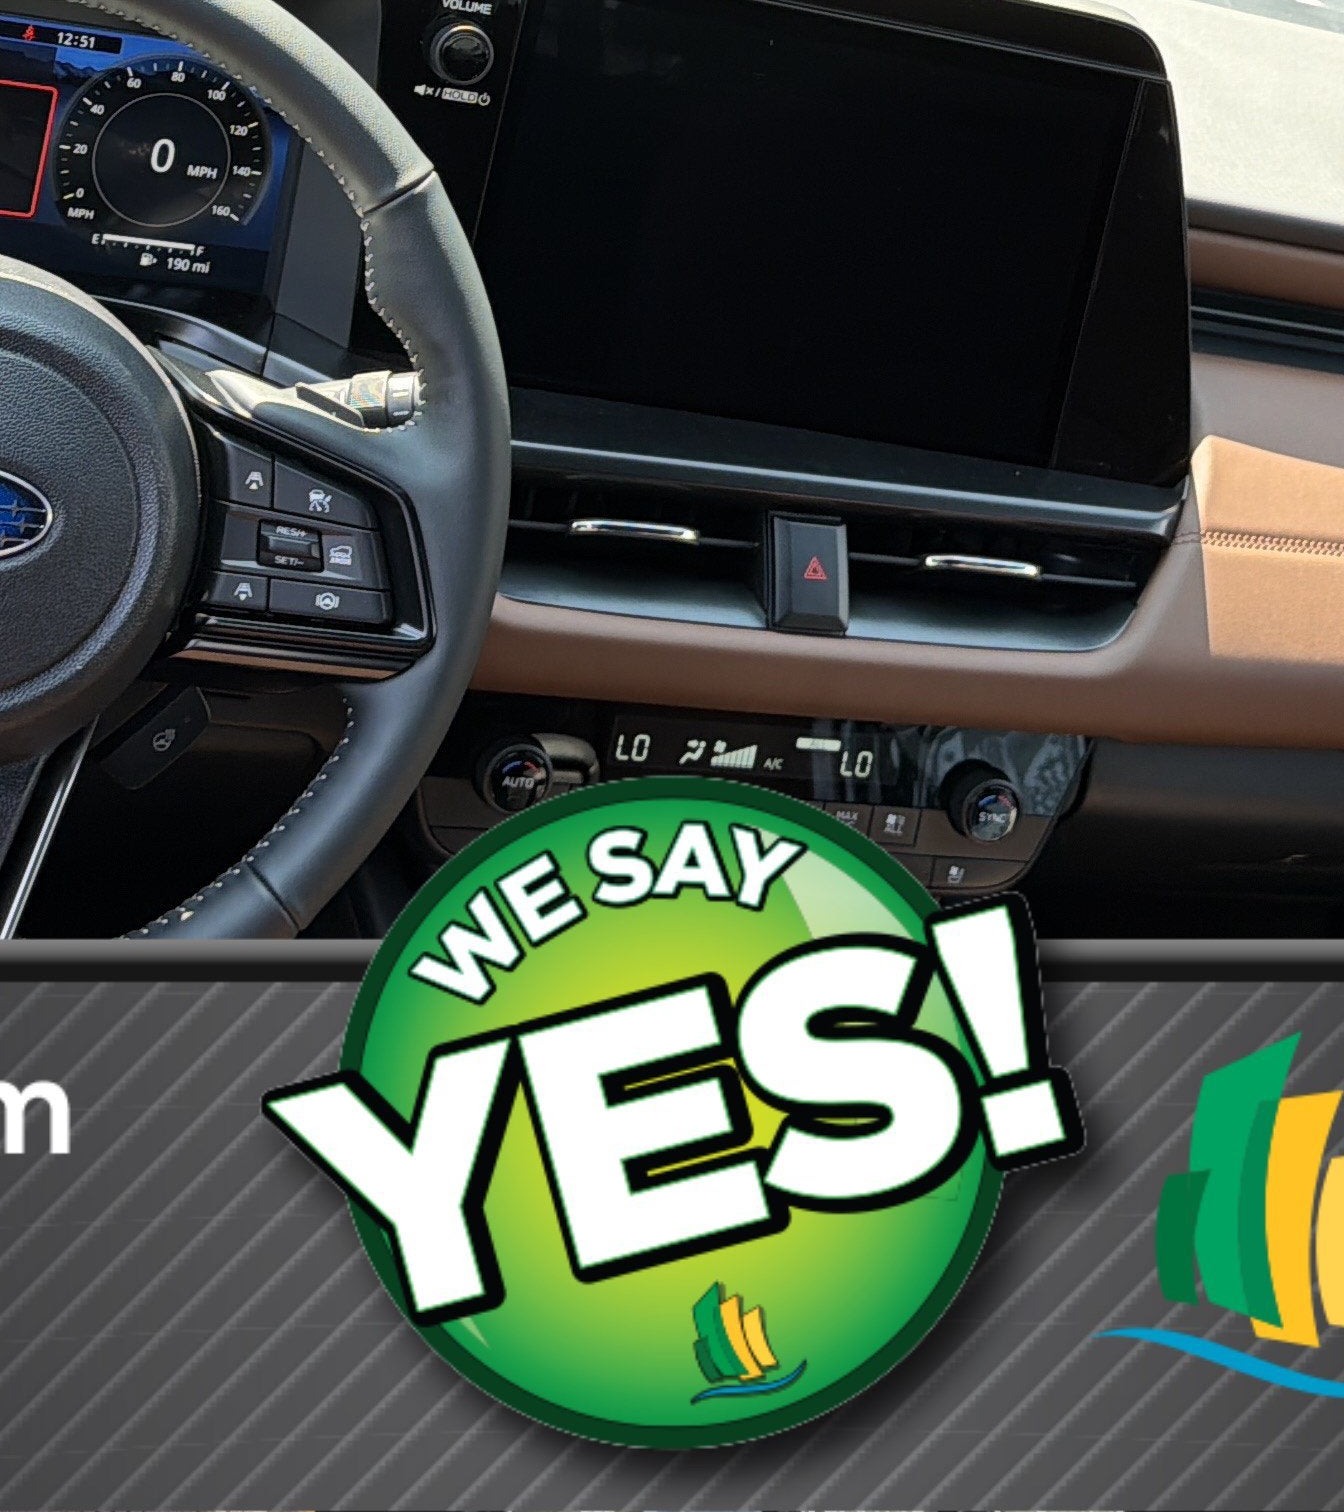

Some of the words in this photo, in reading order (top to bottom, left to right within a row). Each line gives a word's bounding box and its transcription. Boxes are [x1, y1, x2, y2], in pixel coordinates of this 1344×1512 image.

[57, 32, 96, 48] 12:51
[127, 78, 142, 89] 60
[171, 72, 186, 83] 80
[207, 89, 227, 101] 100
[442, 88, 478, 103] HOLD
[90, 104, 105, 116] 40
[229, 125, 249, 137] 120
[73, 143, 88, 155] 20
[150, 138, 176, 173] 0
[186, 164, 218, 180] MPH
[232, 166, 251, 177] 140
[75, 188, 85, 198] 0
[67, 207, 95, 220] MPH
[212, 205, 231, 217] 160
[91, 233, 99, 245] E
[195, 246, 205, 257] F
[166, 257, 191, 272] 190
[192, 260, 210, 273] mi
[616, 734, 651, 762] LO
[763, 758, 783, 771] A/C
[840, 751, 873, 778] LO
[502, 775, 535, 790] AUTO
[978, 811, 1006, 824] SYNC
